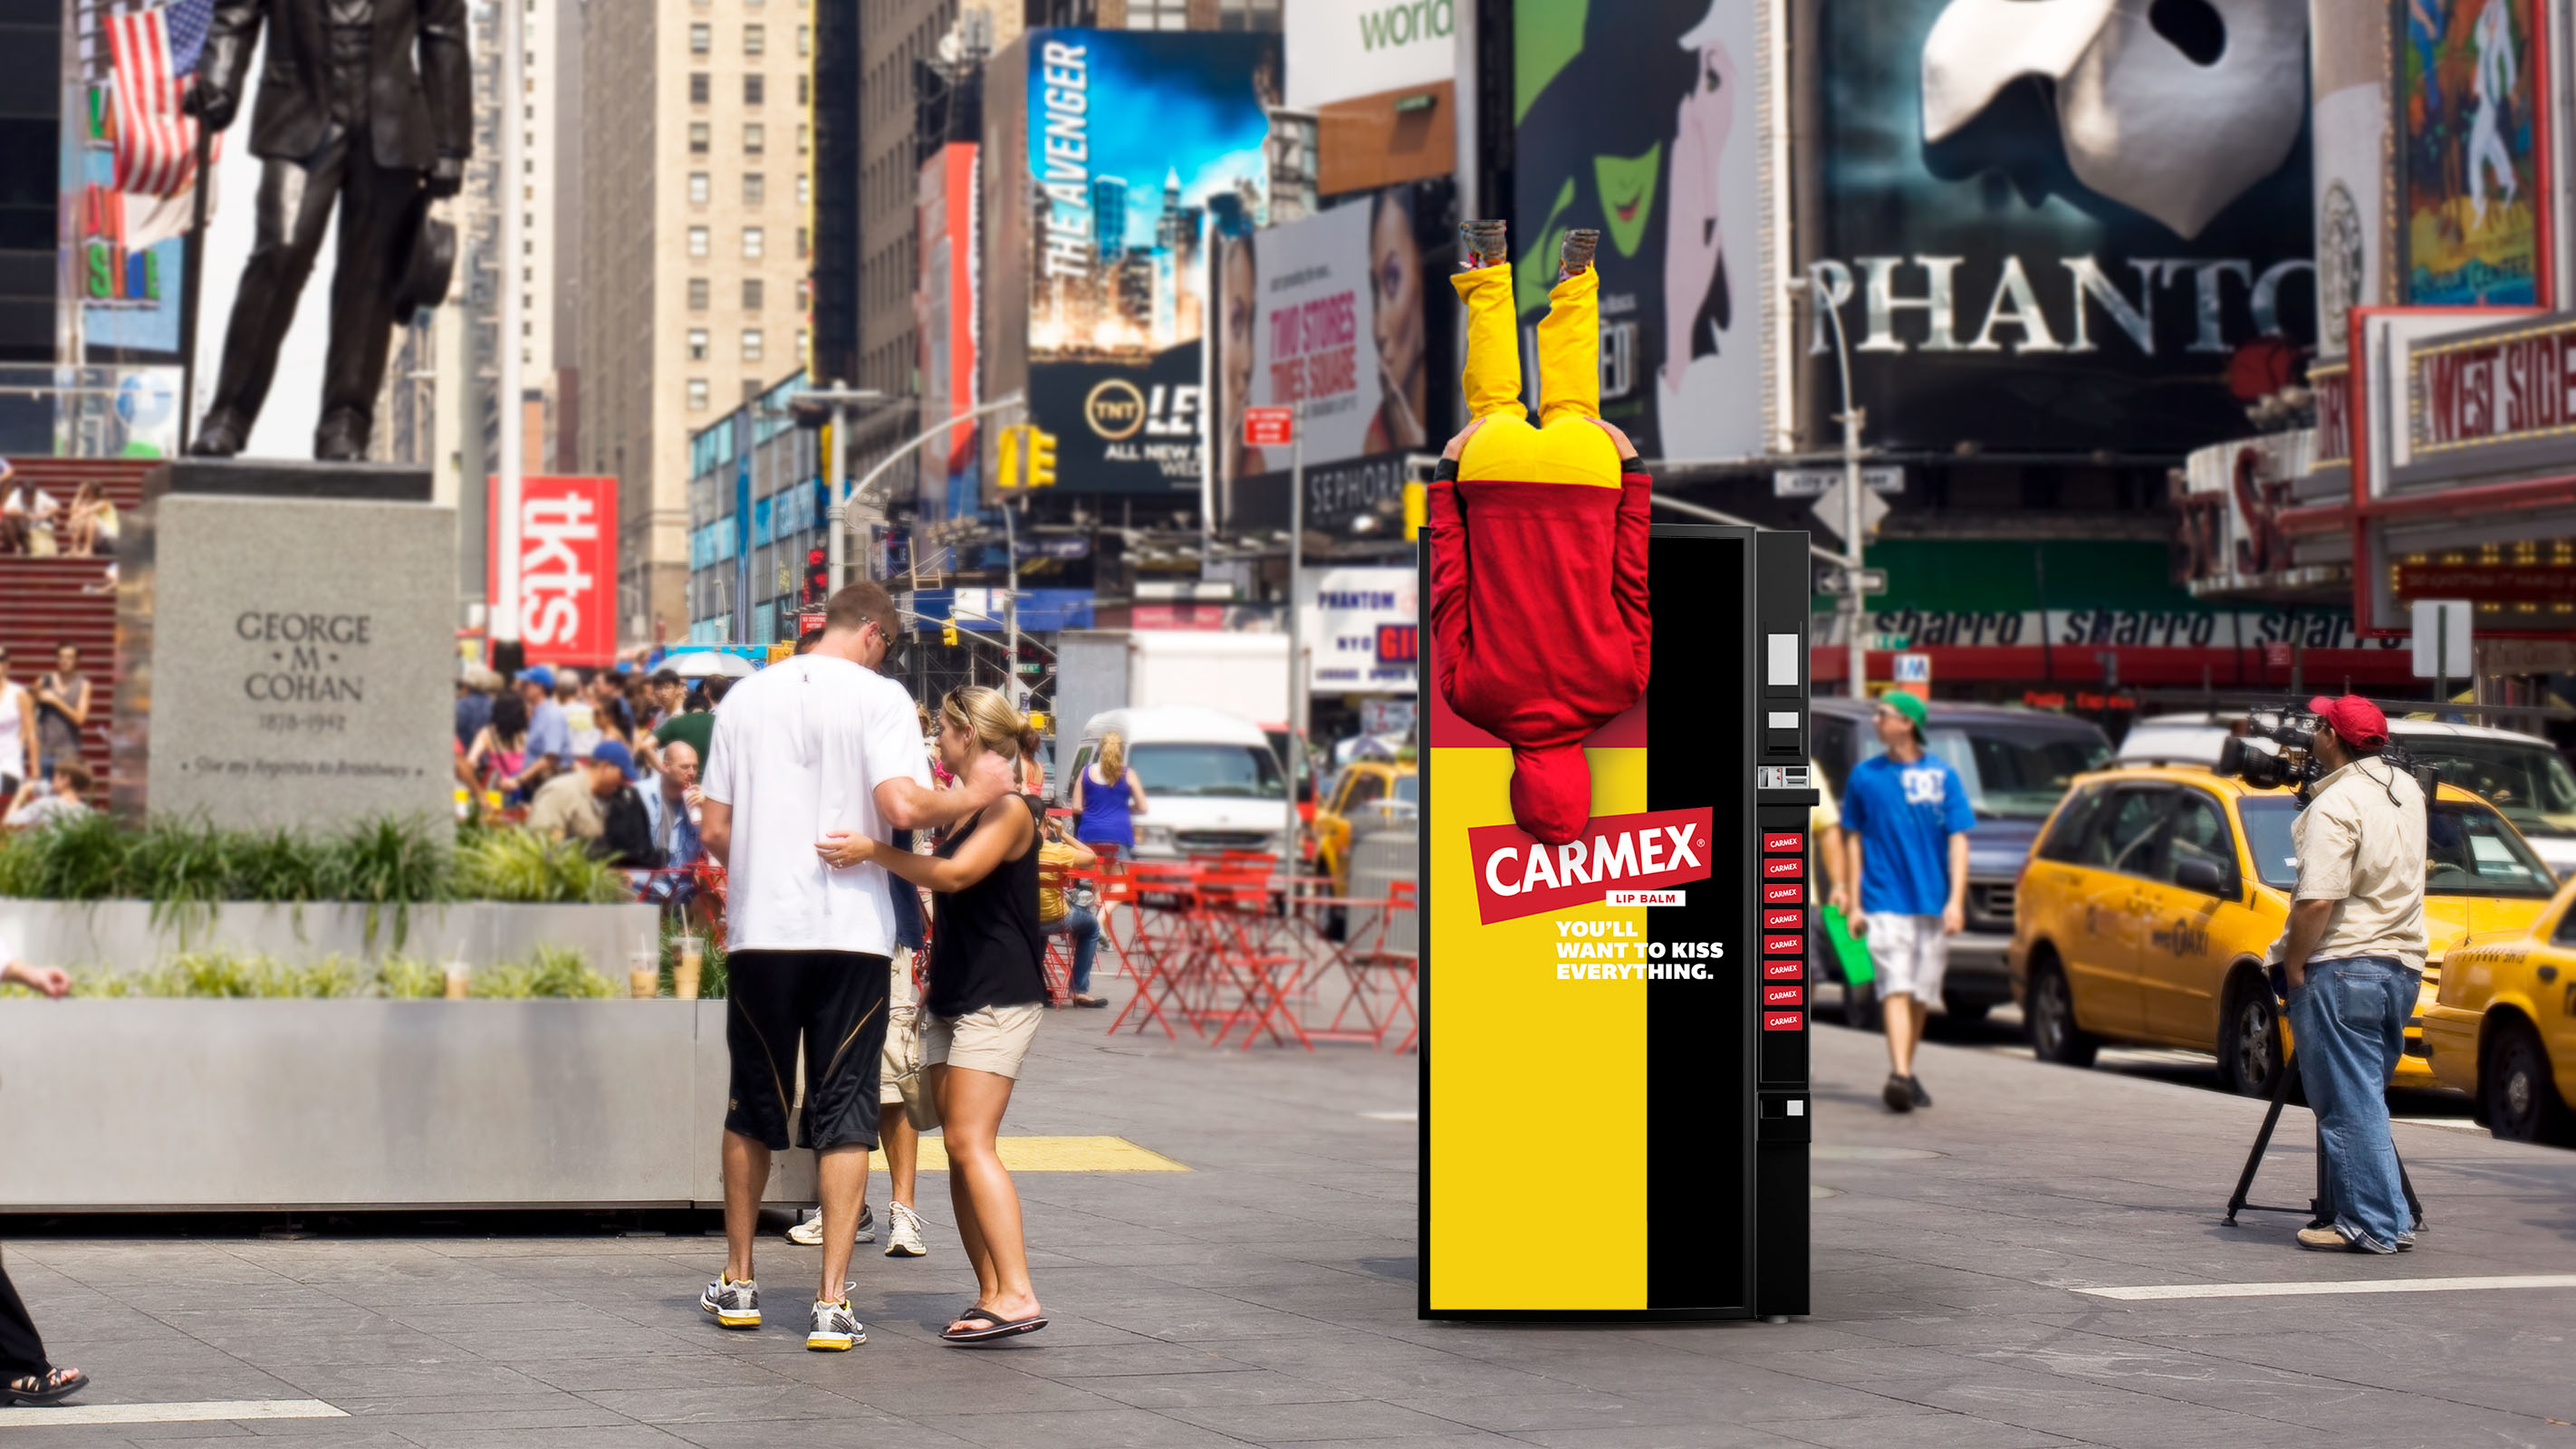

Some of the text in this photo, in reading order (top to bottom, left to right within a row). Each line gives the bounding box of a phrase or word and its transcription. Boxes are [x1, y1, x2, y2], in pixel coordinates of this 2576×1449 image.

[1360, 0, 1455, 52] world
[1043, 41, 1088, 278] THE AVENGER
[1096, 401, 1138, 420] TNT
[1104, 442, 1140, 461] ALL
[1143, 443, 1191, 461] NEW
[522, 490, 598, 646] tkts
[1318, 591, 1395, 609] PHANTOM
[235, 611, 371, 644] GEORGE
[1874, 606, 2023, 647] sbarro
[2062, 605, 2215, 648] sbarro
[291, 646, 321, 673] M
[244, 673, 365, 702] COHAN
[1770, 838, 1798, 848] CARMEX
[1485, 822, 1702, 897] CARMEX
[1770, 863, 1798, 873] CARMEX
[1616, 894, 1677, 904] LIP BALM
[1769, 888, 1797, 898] CARMEX
[1770, 914, 1798, 924] CARMEX
[1555, 920, 1639, 937] YOU'LL
[1555, 942, 1725, 959] WANT TO KISS
[1770, 939, 1798, 950] CARMEX
[1556, 963, 1715, 980] EVERYTHING.
[1770, 964, 1798, 974] CARMEX
[1769, 990, 1797, 1000] CARMEX
[1770, 1016, 1798, 1026] CARMEX
